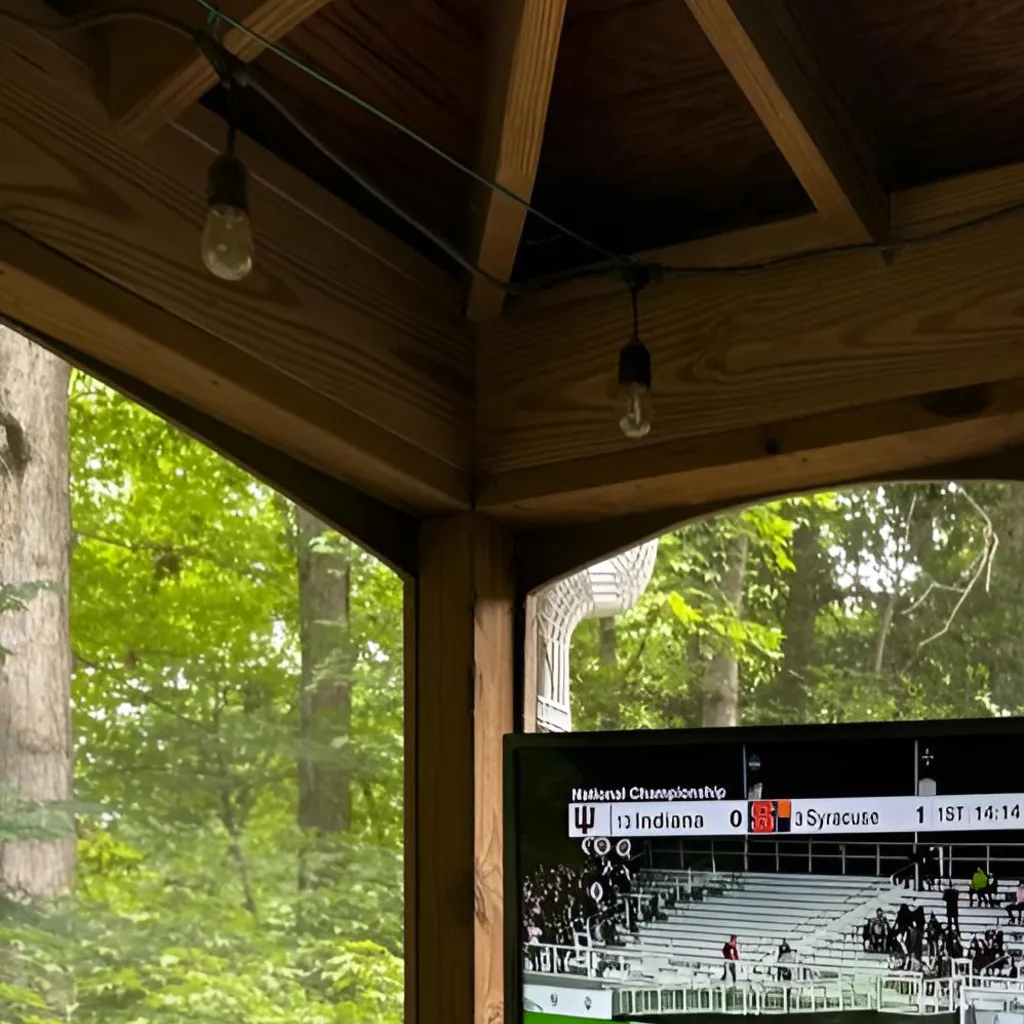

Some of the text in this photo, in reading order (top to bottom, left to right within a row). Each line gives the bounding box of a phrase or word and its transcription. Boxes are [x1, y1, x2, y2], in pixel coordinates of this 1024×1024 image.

[636, 812, 704, 830] Indiana
[730, 809, 742, 828] 0
[806, 809, 879, 830] Syracuse
[916, 805, 924, 824] 1
[938, 806, 964, 822] 1ST
[975, 804, 1020, 821] 14:14
